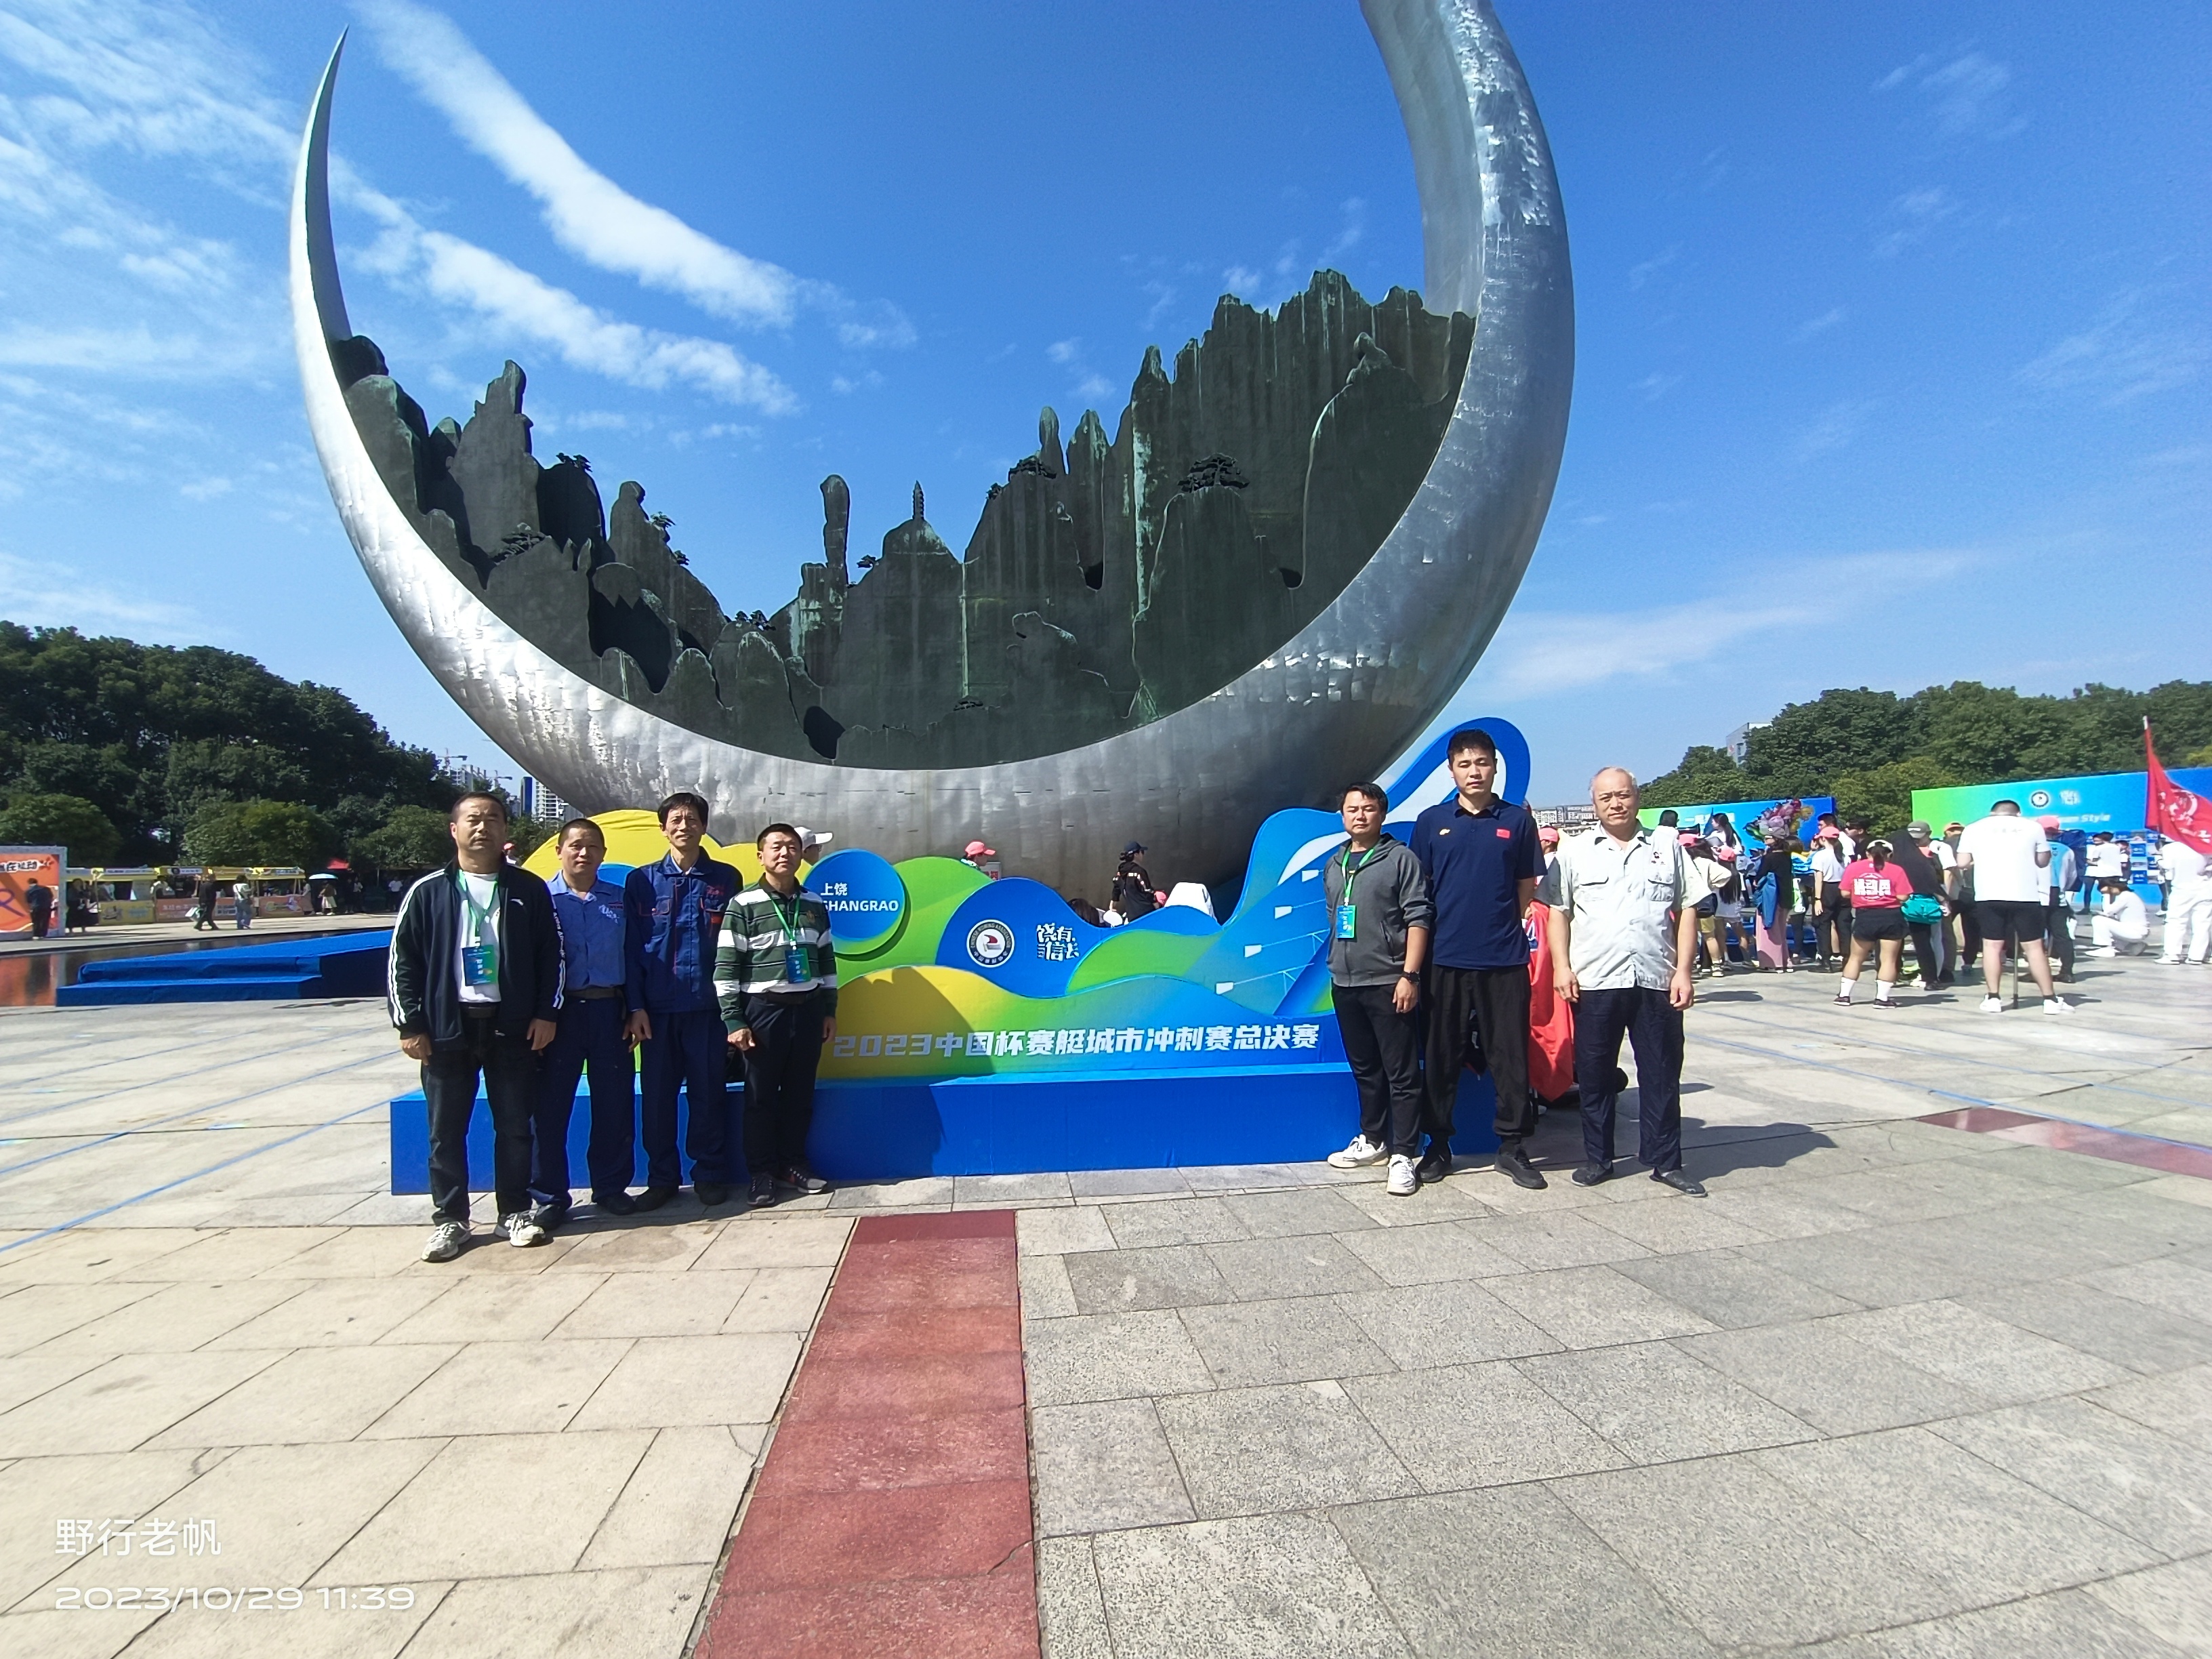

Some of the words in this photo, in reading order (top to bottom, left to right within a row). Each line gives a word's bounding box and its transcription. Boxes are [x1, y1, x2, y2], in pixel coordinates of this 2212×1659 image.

[2082, 813, 2111, 823] Style
[820, 882, 848, 896] 上饶
[833, 1024, 1320, 1057] 2023中国杯赛艇城市冲刺赛总决赛
